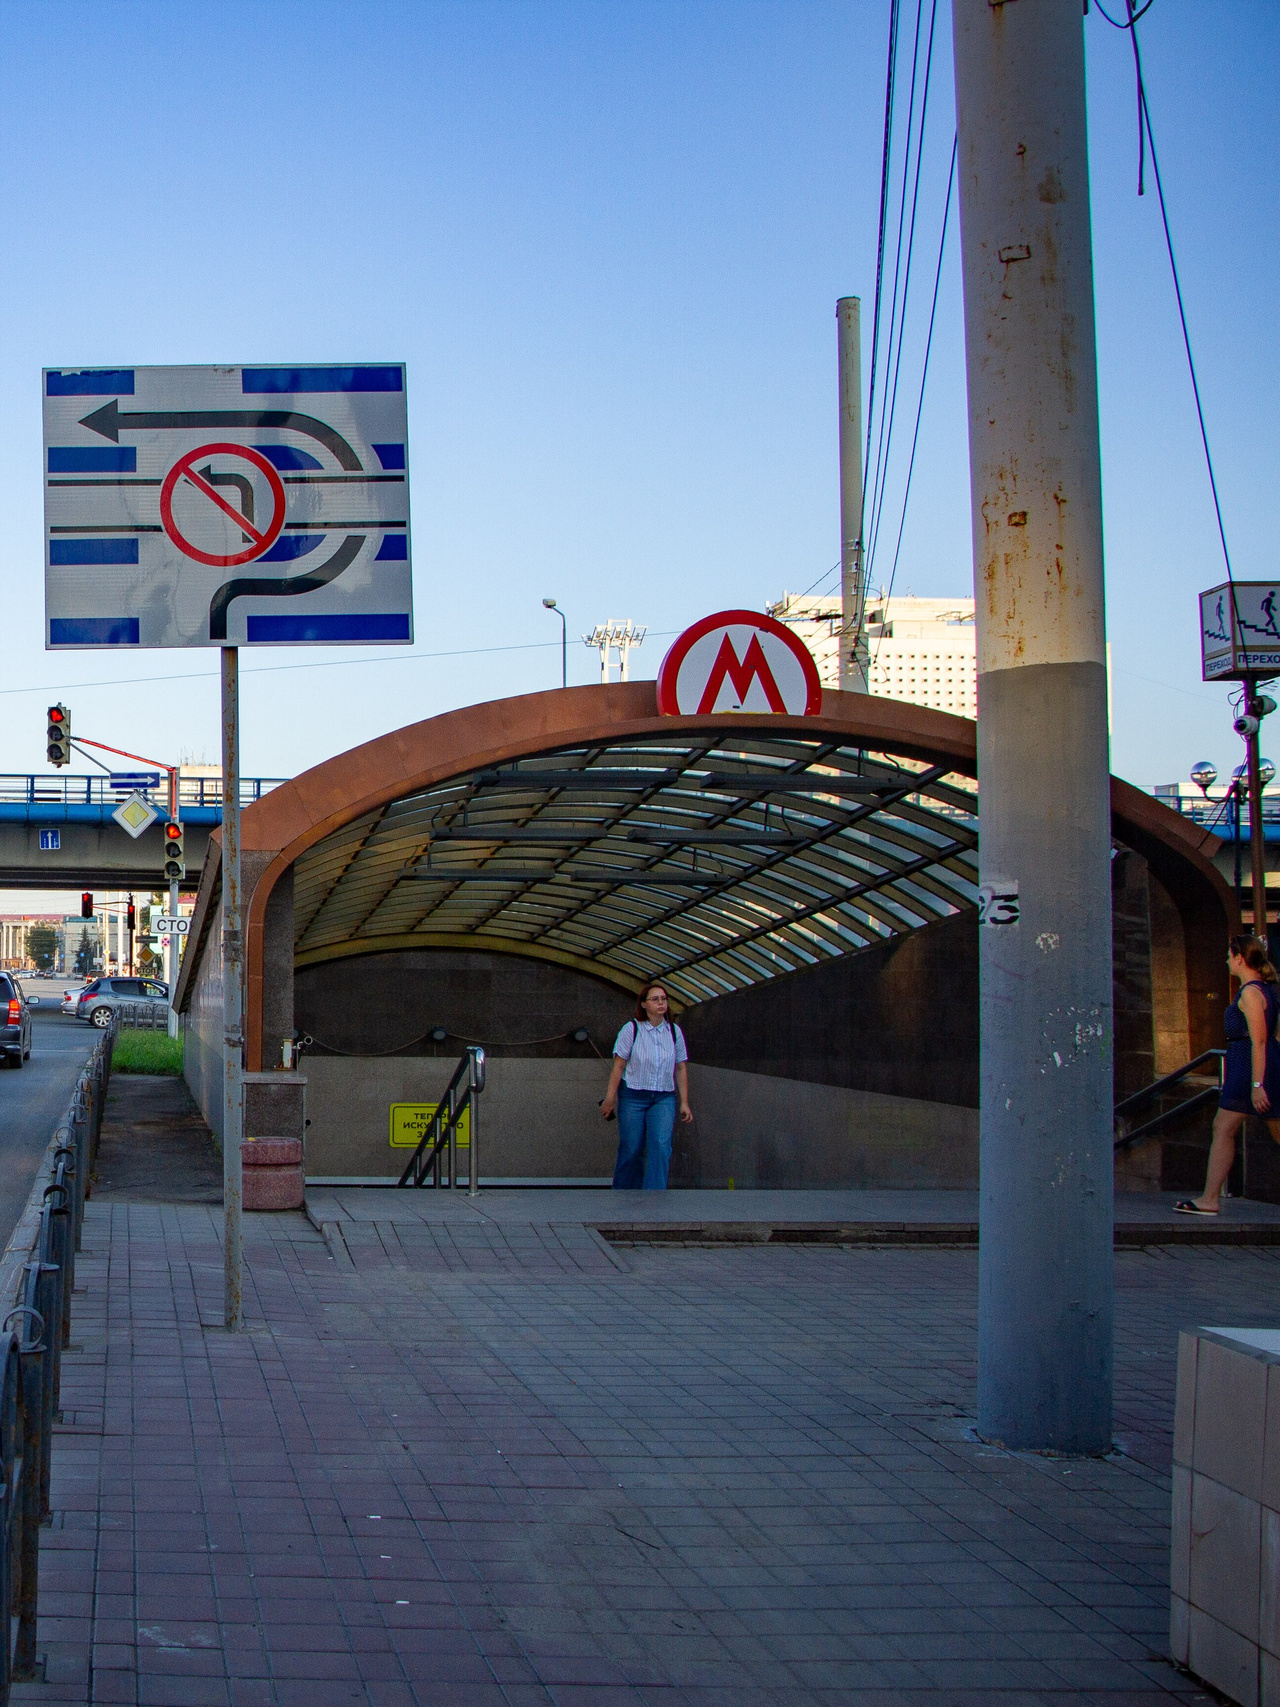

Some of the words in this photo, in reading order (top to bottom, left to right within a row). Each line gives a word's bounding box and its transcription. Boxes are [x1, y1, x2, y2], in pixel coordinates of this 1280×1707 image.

[1206, 657, 1231, 672] ПЕРЕХОД
[1238, 654, 1280, 664] ПЕРЕХО
[157, 919, 188, 932] СТО
